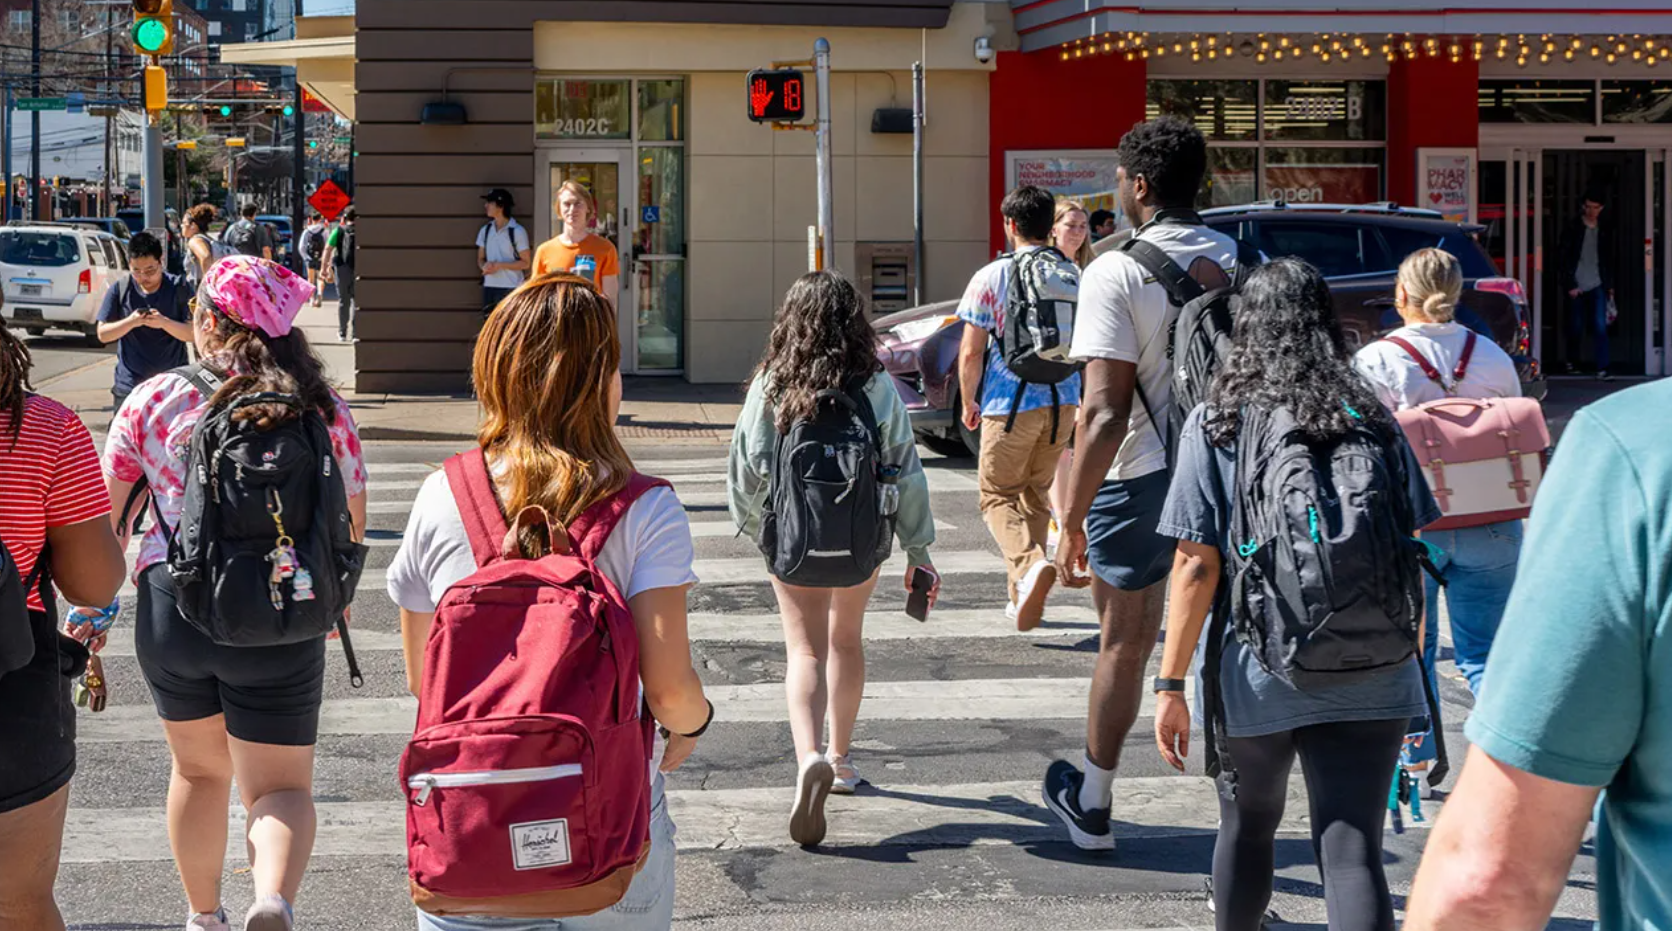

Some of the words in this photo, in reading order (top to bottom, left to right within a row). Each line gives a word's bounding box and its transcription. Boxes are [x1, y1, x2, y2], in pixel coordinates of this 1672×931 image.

[783, 79, 801, 111] 18
[1285, 96, 1338, 120] 2402
[1347, 96, 1362, 120] B
[554, 118, 609, 136] 2402C
[1019, 162, 1045, 170] YOUR
[1019, 170, 1096, 179] NEIGHBORHOOD
[1427, 168, 1466, 180] PHAR
[1019, 179, 1071, 187] PHARMACY
[1427, 179, 1464, 190] MACY
[1271, 186, 1323, 203] open
[520, 829, 560, 852] Herschel
